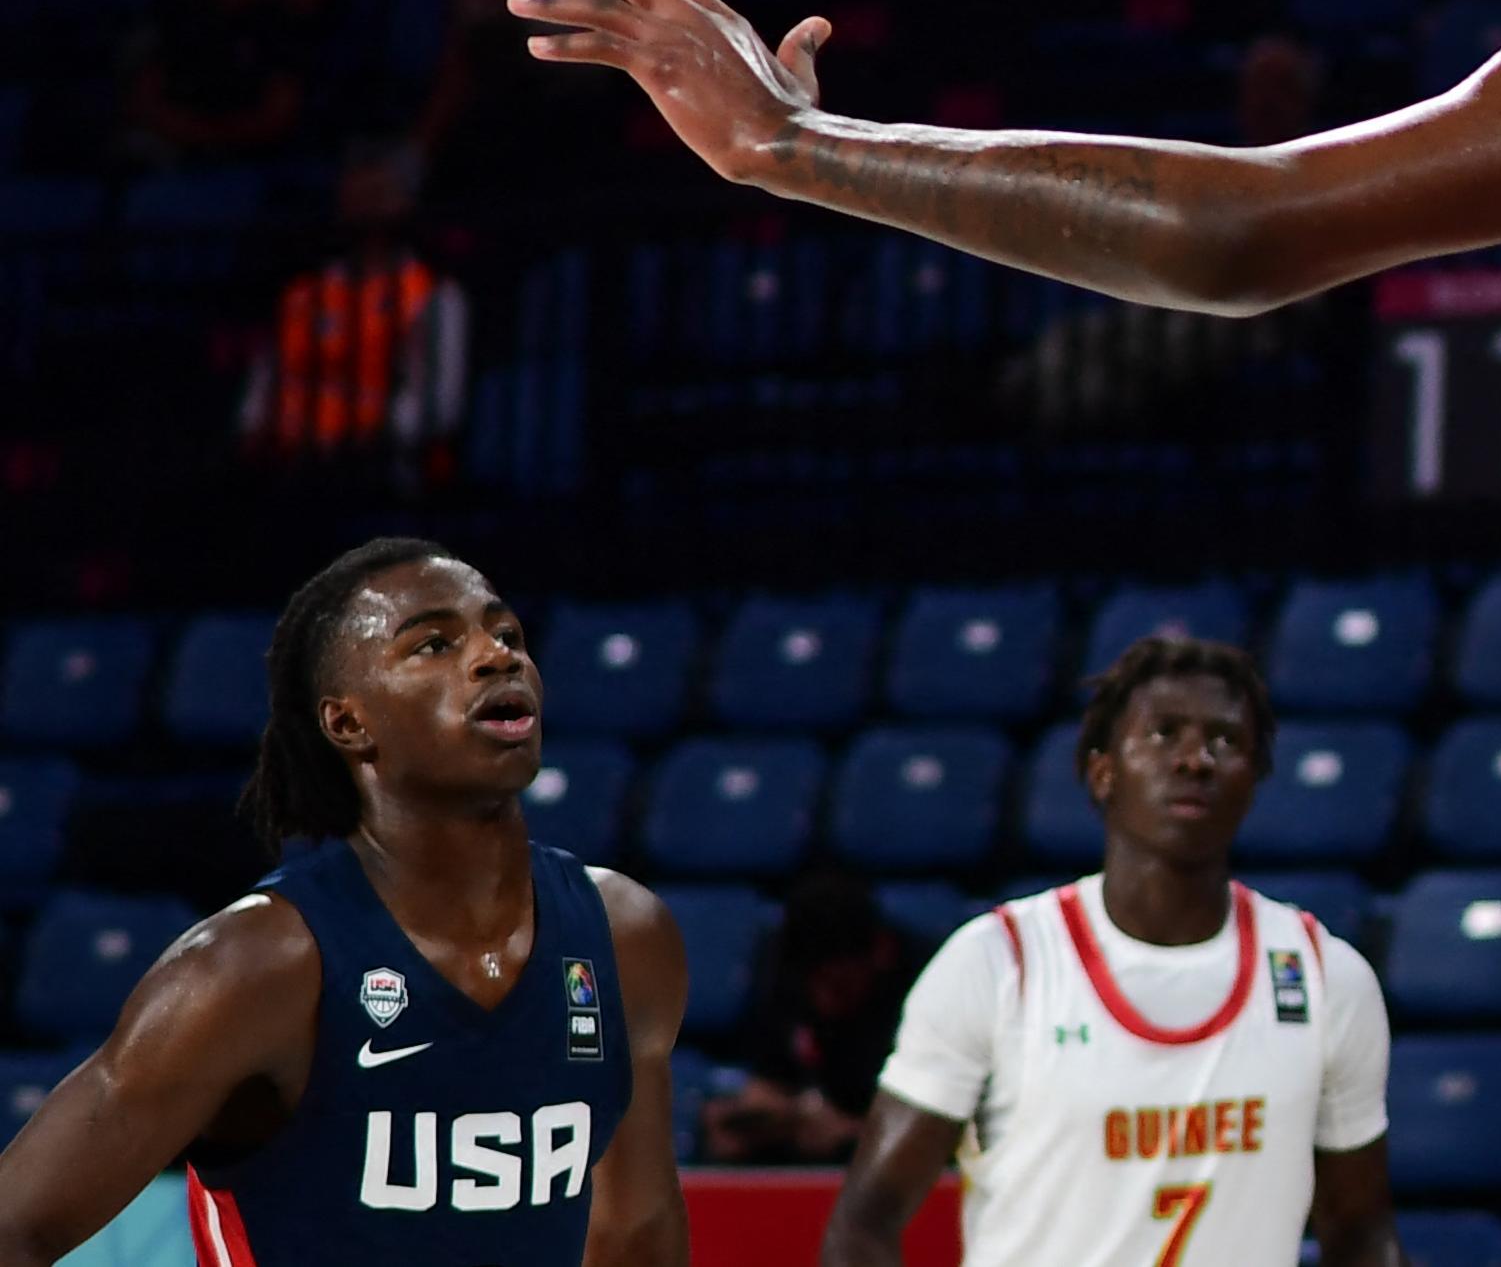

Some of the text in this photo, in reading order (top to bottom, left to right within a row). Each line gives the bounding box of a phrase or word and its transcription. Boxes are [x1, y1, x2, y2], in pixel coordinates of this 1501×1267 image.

[360, 1100, 591, 1212] USA
[1104, 1097, 1266, 1161] GUINEE
[1151, 1181, 1213, 1267] 7
